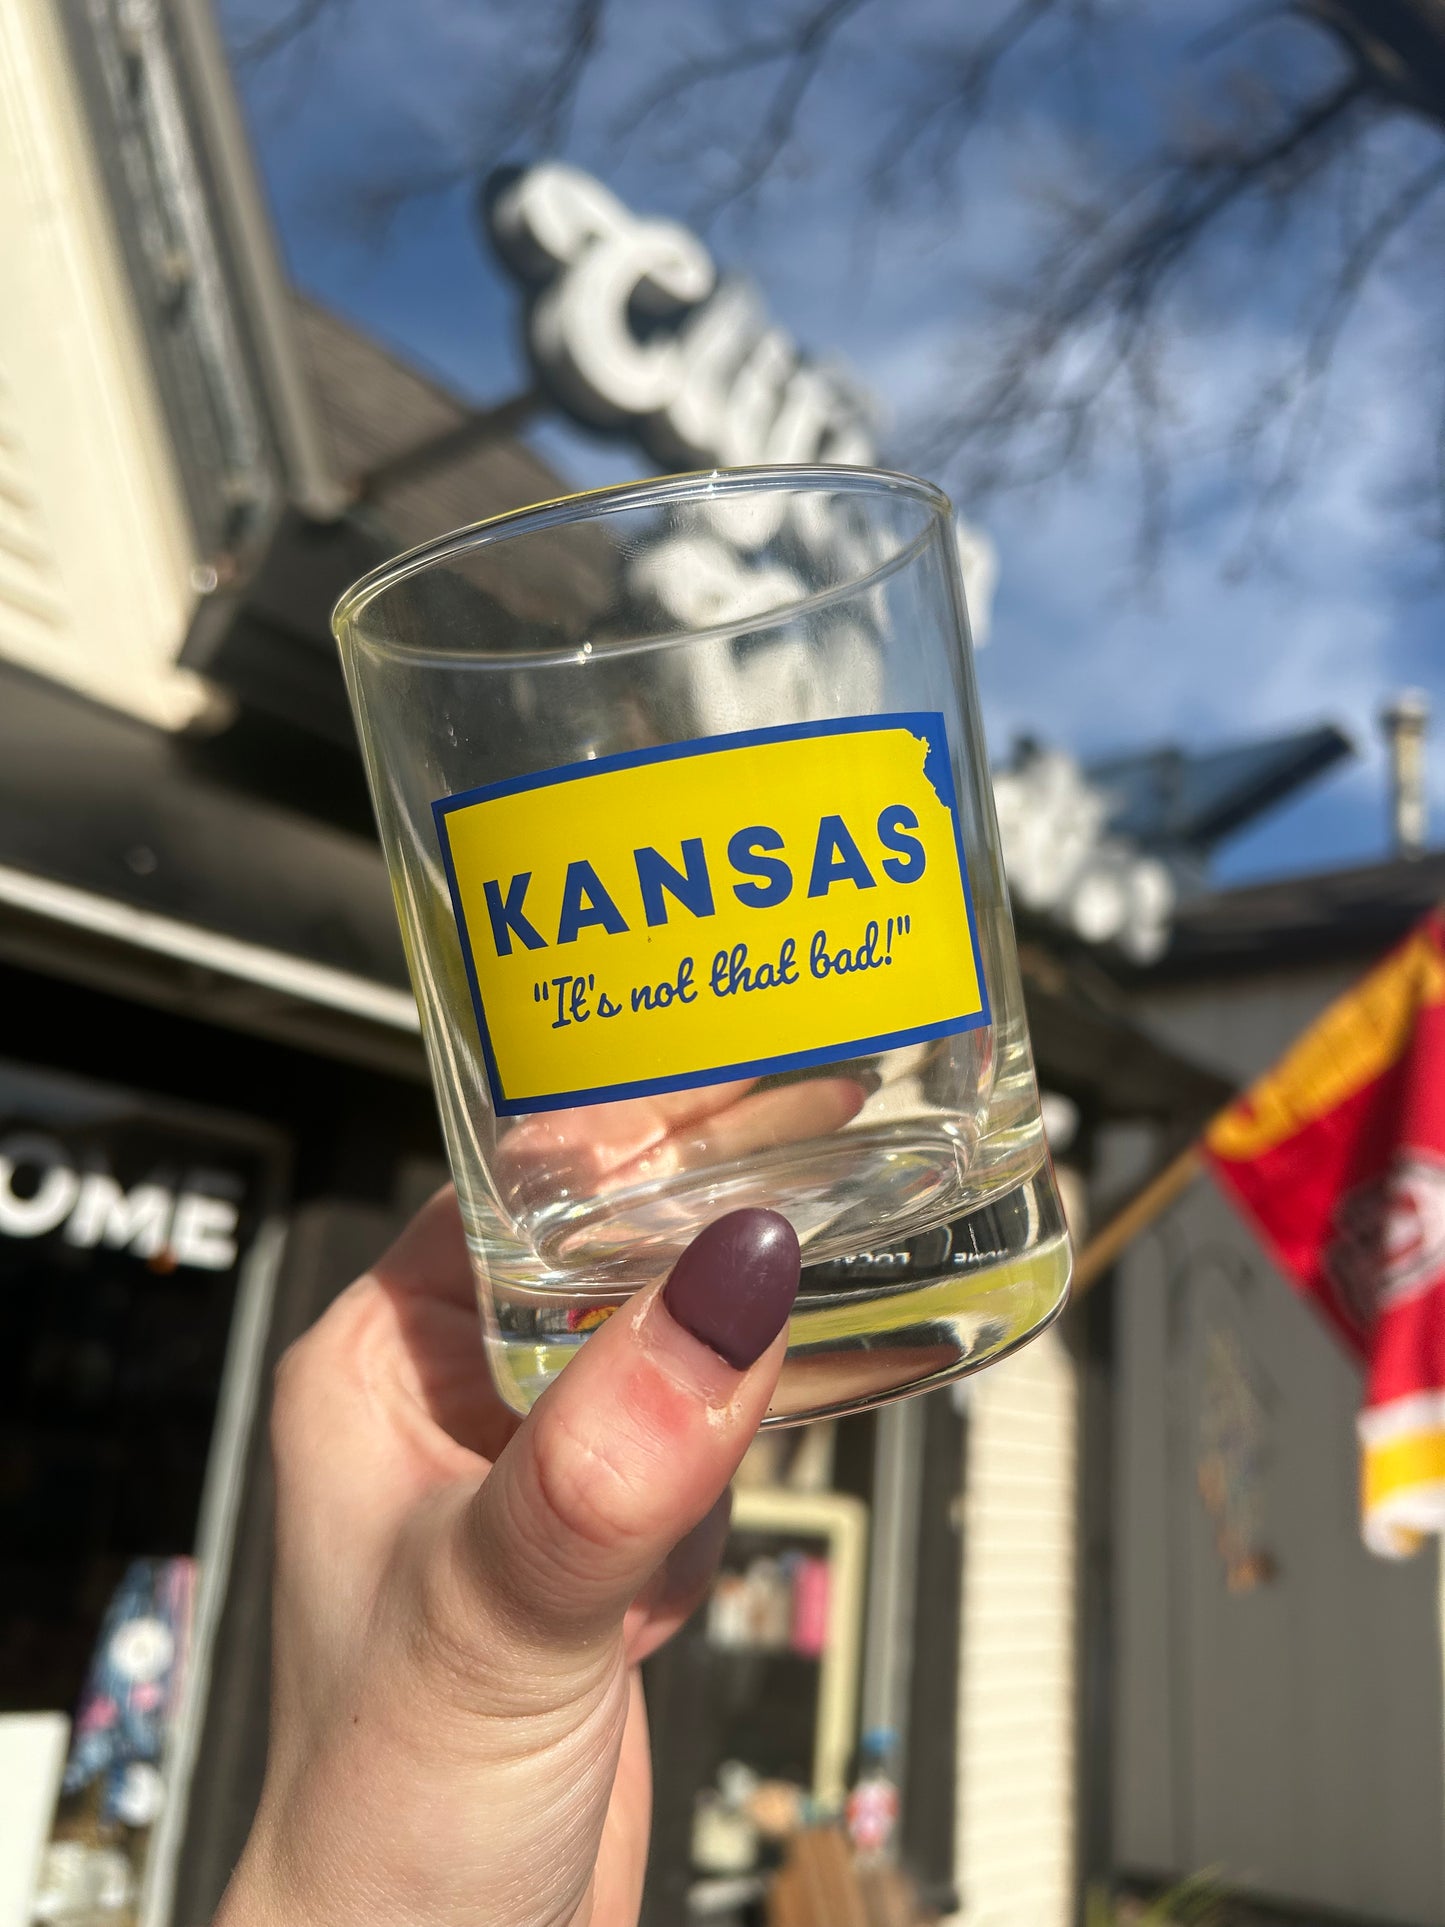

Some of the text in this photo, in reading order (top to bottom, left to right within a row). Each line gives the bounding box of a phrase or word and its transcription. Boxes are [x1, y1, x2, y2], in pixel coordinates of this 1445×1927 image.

[482, 804, 927, 958] KANSAS
[533, 914, 912, 1030] "It's not that bad!"
